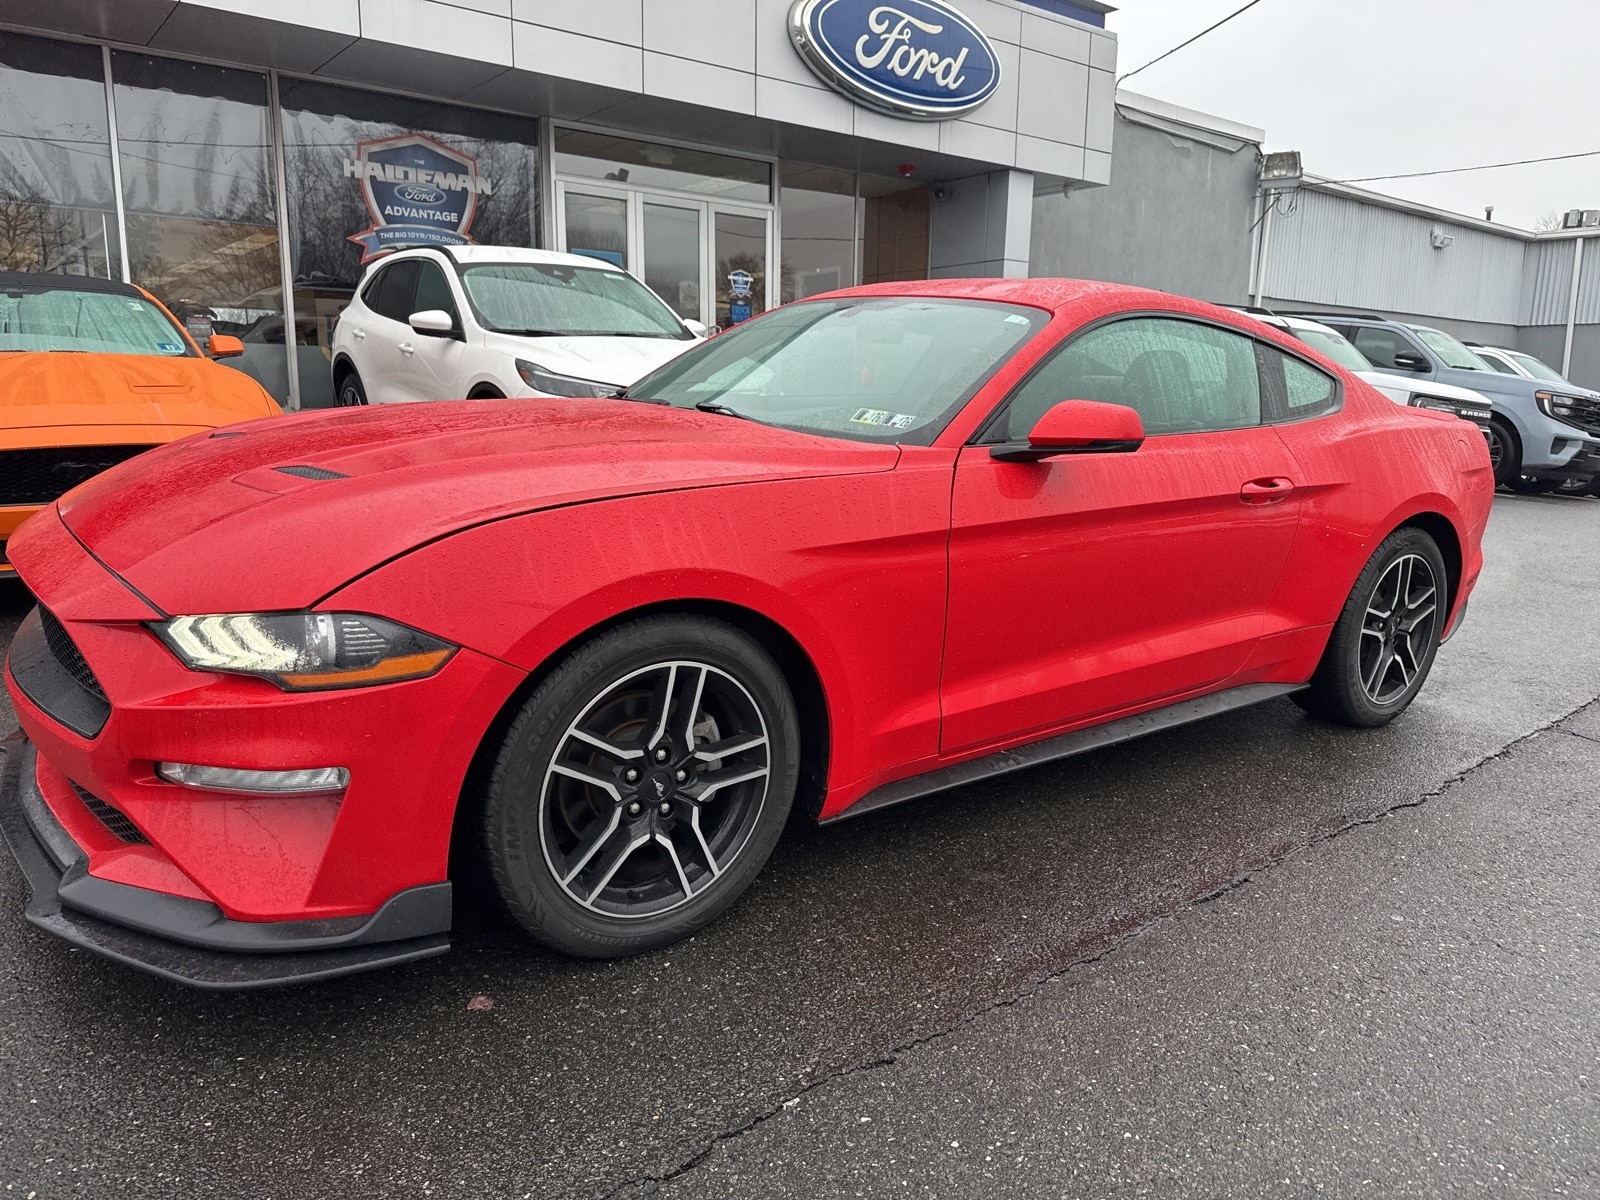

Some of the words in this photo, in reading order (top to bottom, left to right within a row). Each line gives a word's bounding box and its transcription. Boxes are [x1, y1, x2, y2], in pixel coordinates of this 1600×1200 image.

[855, 6, 969, 90] Ford
[343, 159, 492, 195] HALDEMAN
[404, 186, 436, 203] Ford
[384, 205, 459, 223] ADVANTAGE
[380, 231, 394, 239] THE
[1460, 410, 1491, 419] BRONCO
